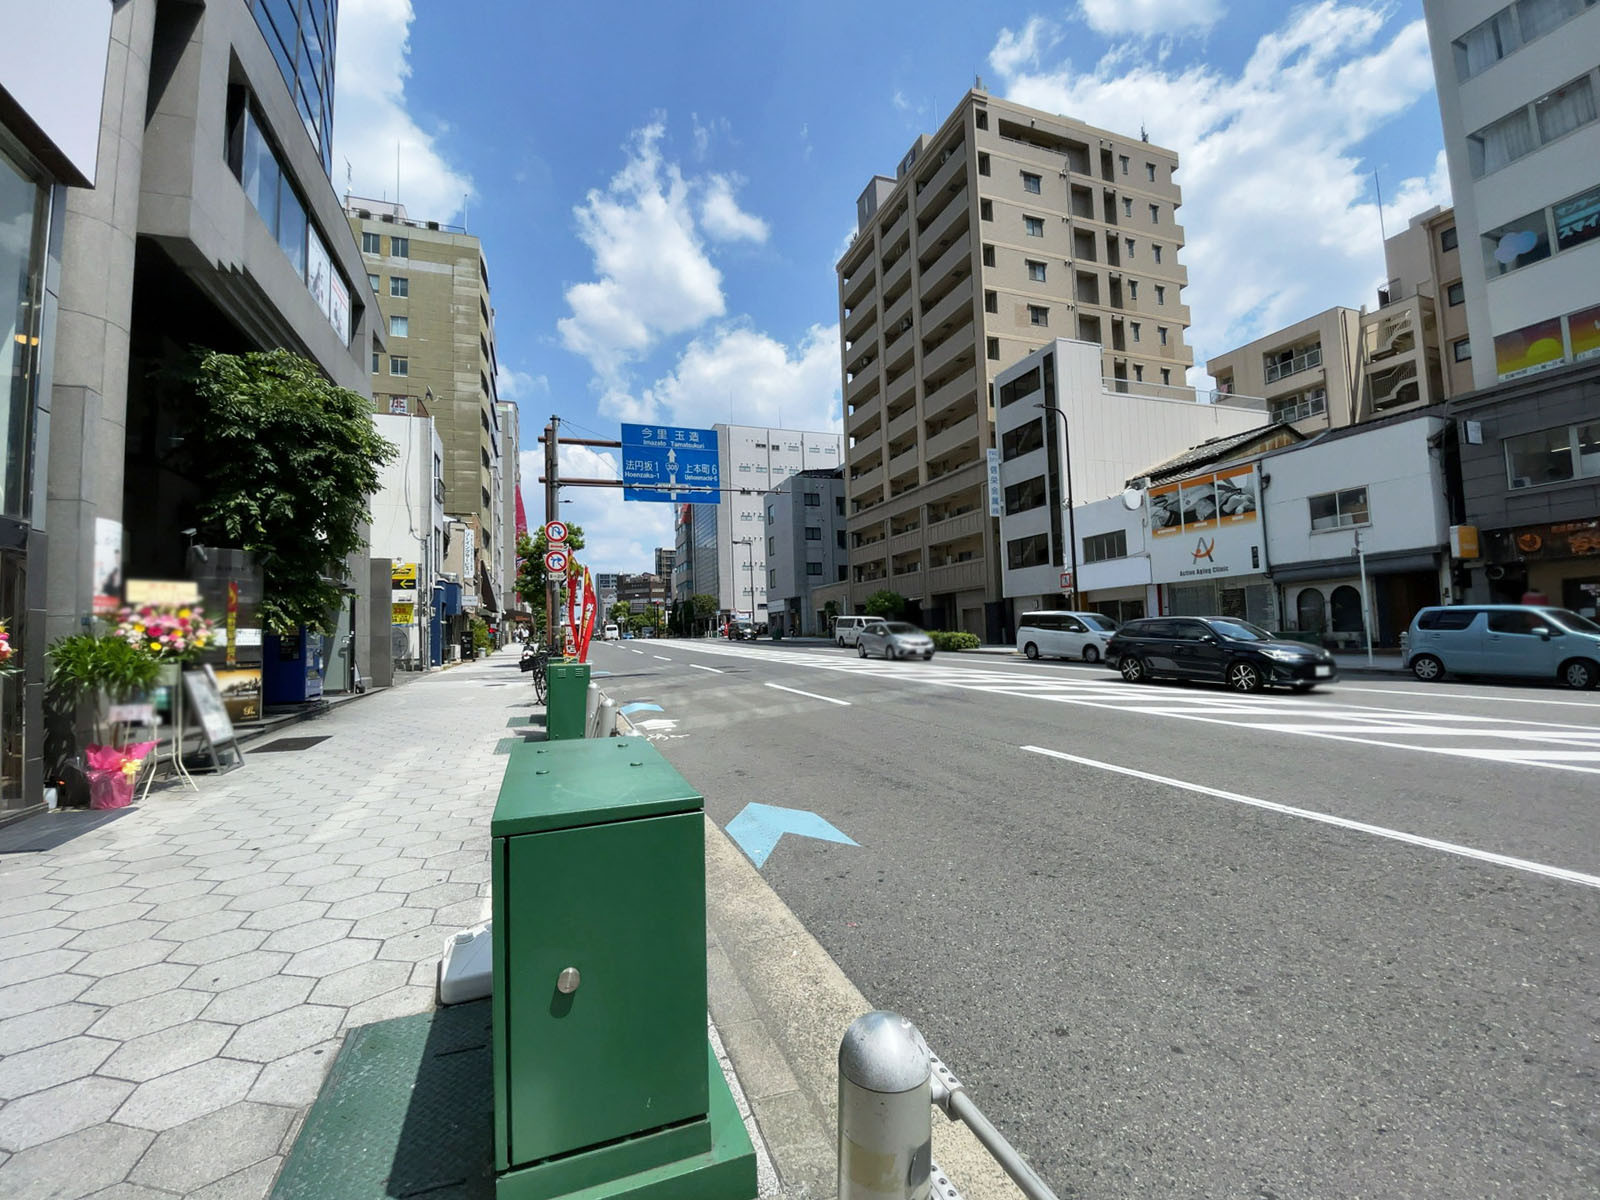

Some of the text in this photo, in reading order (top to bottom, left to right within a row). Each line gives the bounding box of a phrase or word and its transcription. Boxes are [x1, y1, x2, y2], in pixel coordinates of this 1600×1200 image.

[641, 428, 699, 442] 今里 玉造
[670, 441, 705, 449] Tamatsukuri
[625, 460, 659, 471] 法円坂1
[685, 464, 718, 474] 上本町6
